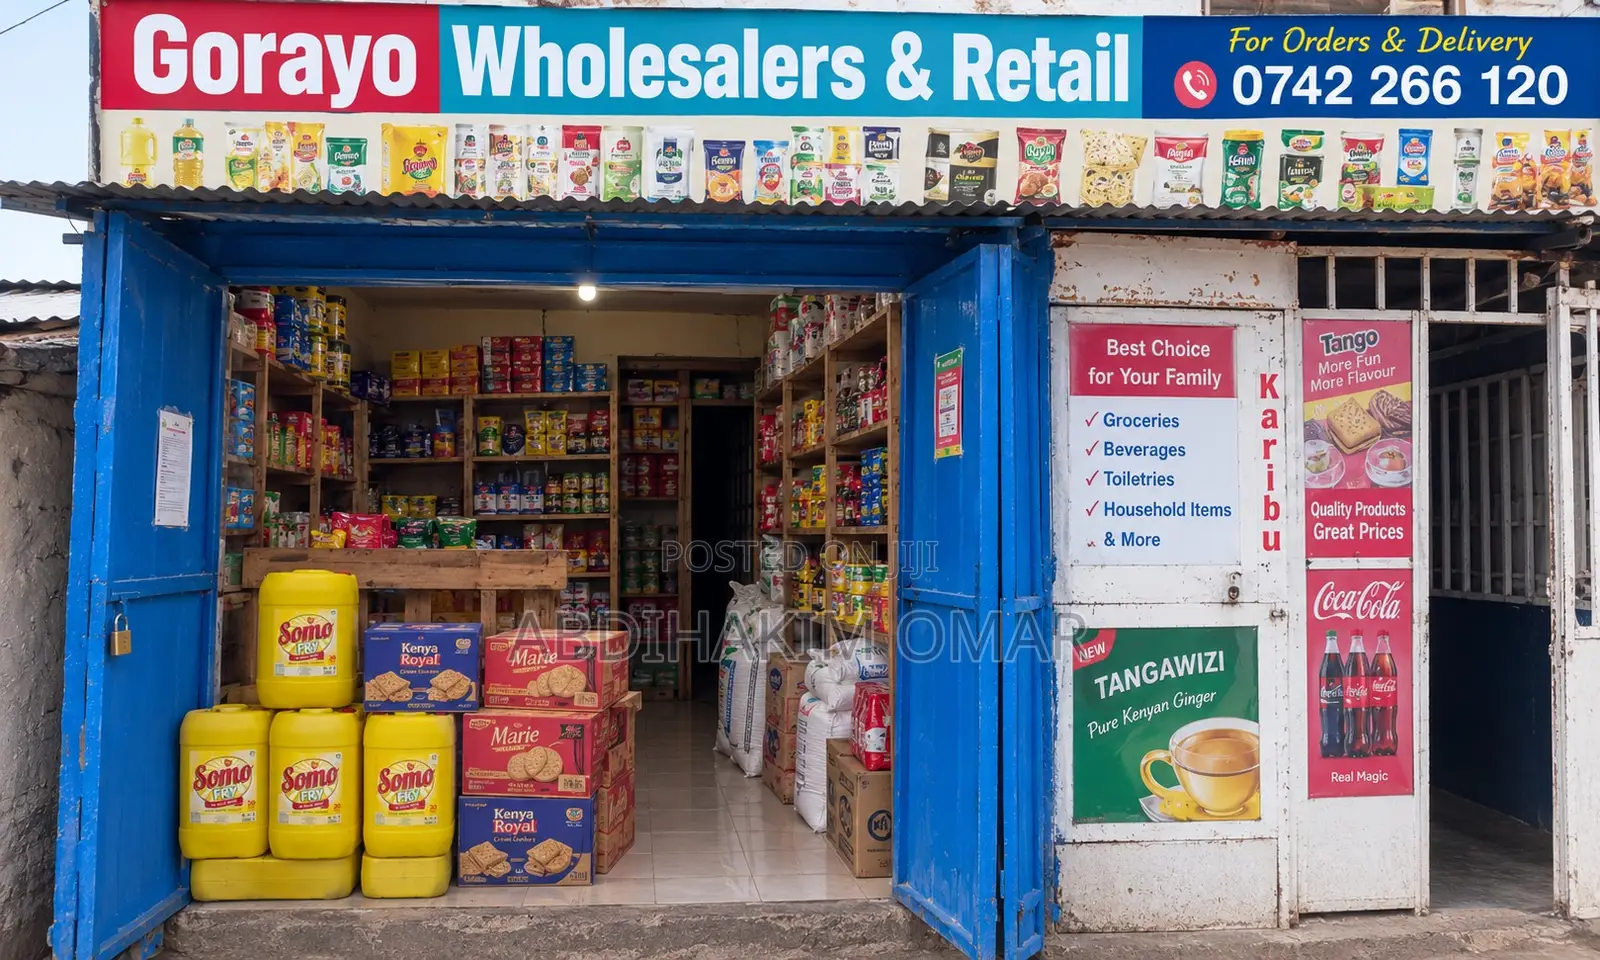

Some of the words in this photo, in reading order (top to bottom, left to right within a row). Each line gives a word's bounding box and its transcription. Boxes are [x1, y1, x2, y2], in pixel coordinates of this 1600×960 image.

[1229, 26, 1273, 53] For
[1282, 26, 1370, 53] Orders
[1381, 27, 1405, 53] &
[1417, 26, 1533, 60] Delivery
[132, 13, 418, 109] Gorayo
[451, 24, 867, 101] Wholesalers
[886, 30, 934, 101] &
[953, 32, 1129, 103] Retail
[1232, 64, 1353, 106] 0742
[1370, 64, 1462, 106] 266
[1481, 64, 1568, 106] 120
[1106, 338, 1146, 357] Best
[1151, 339, 1211, 358] Choice
[1320, 329, 1379, 355] Tango
[1318, 359, 1352, 376] More
[1356, 353, 1381, 370] Fun
[1088, 367, 1114, 385] for
[1119, 367, 1160, 385] Your
[1166, 367, 1222, 390] Family
[1310, 377, 1344, 393] More
[1348, 365, 1396, 385] Flavour
[1103, 412, 1180, 429] Groceries
[1104, 441, 1186, 461] Beverages
[1259, 373, 1281, 552] Karibu
[1103, 470, 1175, 487] Toiletries
[1104, 501, 1186, 517] Household
[1190, 501, 1232, 517] Items
[1310, 501, 1352, 519] Quality
[1355, 501, 1406, 517] Products
[1103, 531, 1116, 548] &
[1121, 531, 1161, 547] More
[1313, 522, 1355, 540] Great
[1359, 522, 1404, 540] Prices
[277, 621, 334, 646] Somo
[401, 642, 438, 655] Kenya
[511, 648, 558, 667] Marie
[1079, 642, 1106, 663] NEW
[401, 653, 439, 667] Royal
[1094, 650, 1225, 700] TANGAWIZI
[1087, 718, 1119, 739] Pure
[1122, 700, 1170, 726] Kenyan
[1173, 691, 1217, 709] Ginger
[490, 726, 540, 746] Marie
[193, 763, 254, 792] Somo
[281, 766, 339, 794] Somo
[378, 767, 435, 795] Somo
[1331, 771, 1354, 783] Real
[1356, 770, 1389, 784] Magic
[493, 808, 534, 822] Kenya
[494, 819, 536, 835] Royal
